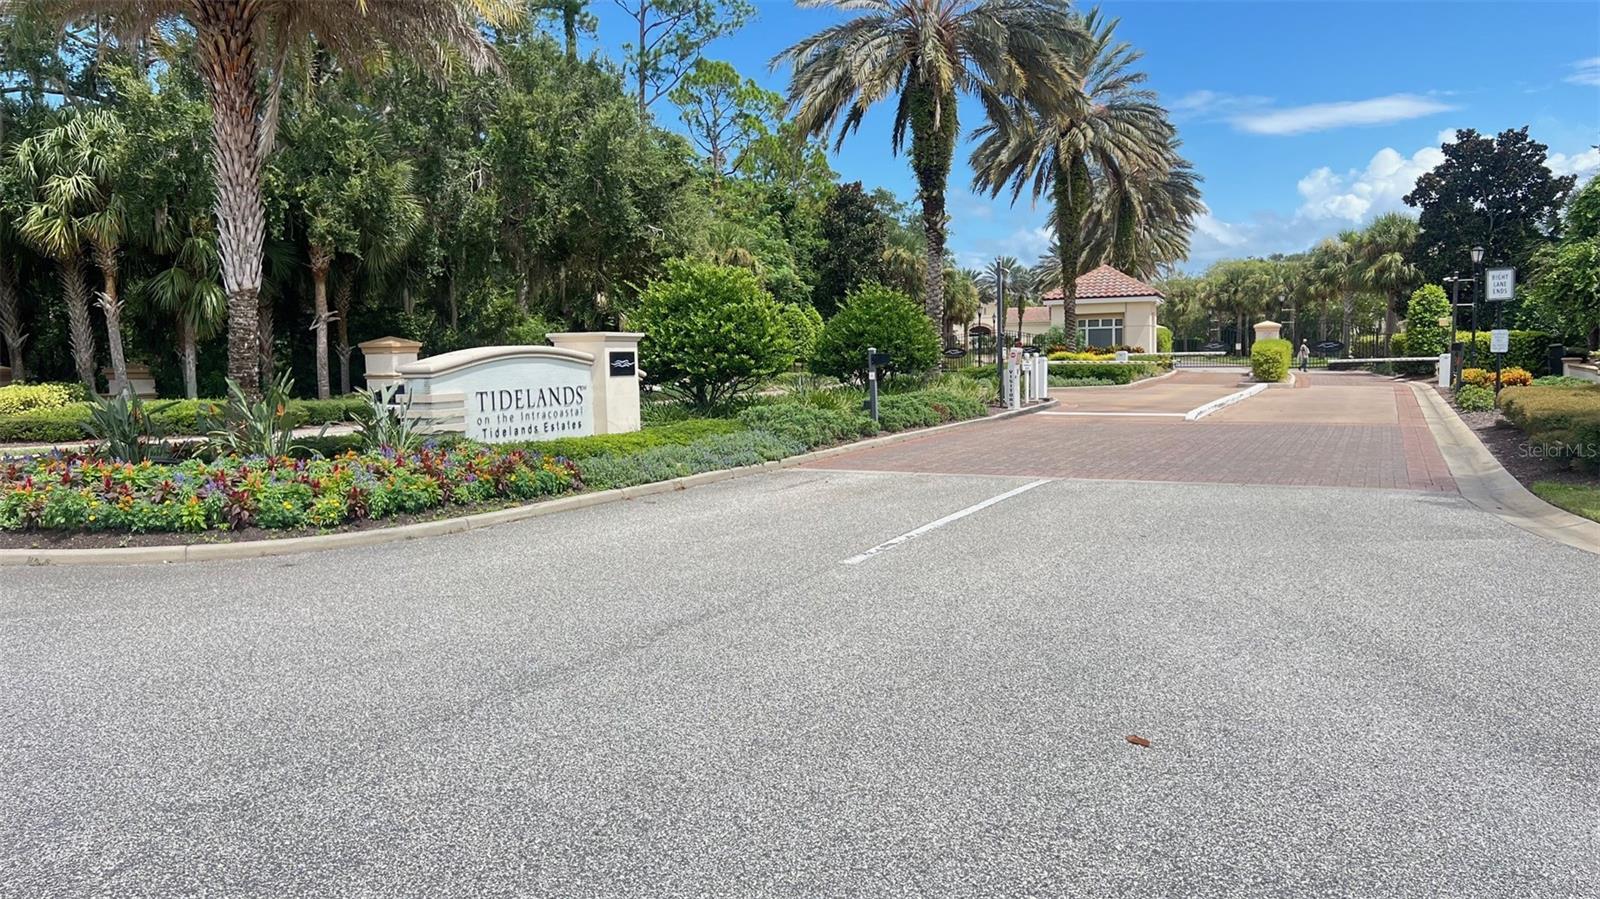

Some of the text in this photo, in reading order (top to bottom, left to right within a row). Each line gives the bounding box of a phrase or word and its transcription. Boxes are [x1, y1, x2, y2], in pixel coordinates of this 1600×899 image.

[475, 385, 584, 412] TIDELANDS
[476, 406, 584, 426] on the Intracoastal
[482, 420, 582, 439] Tidelands Estates
